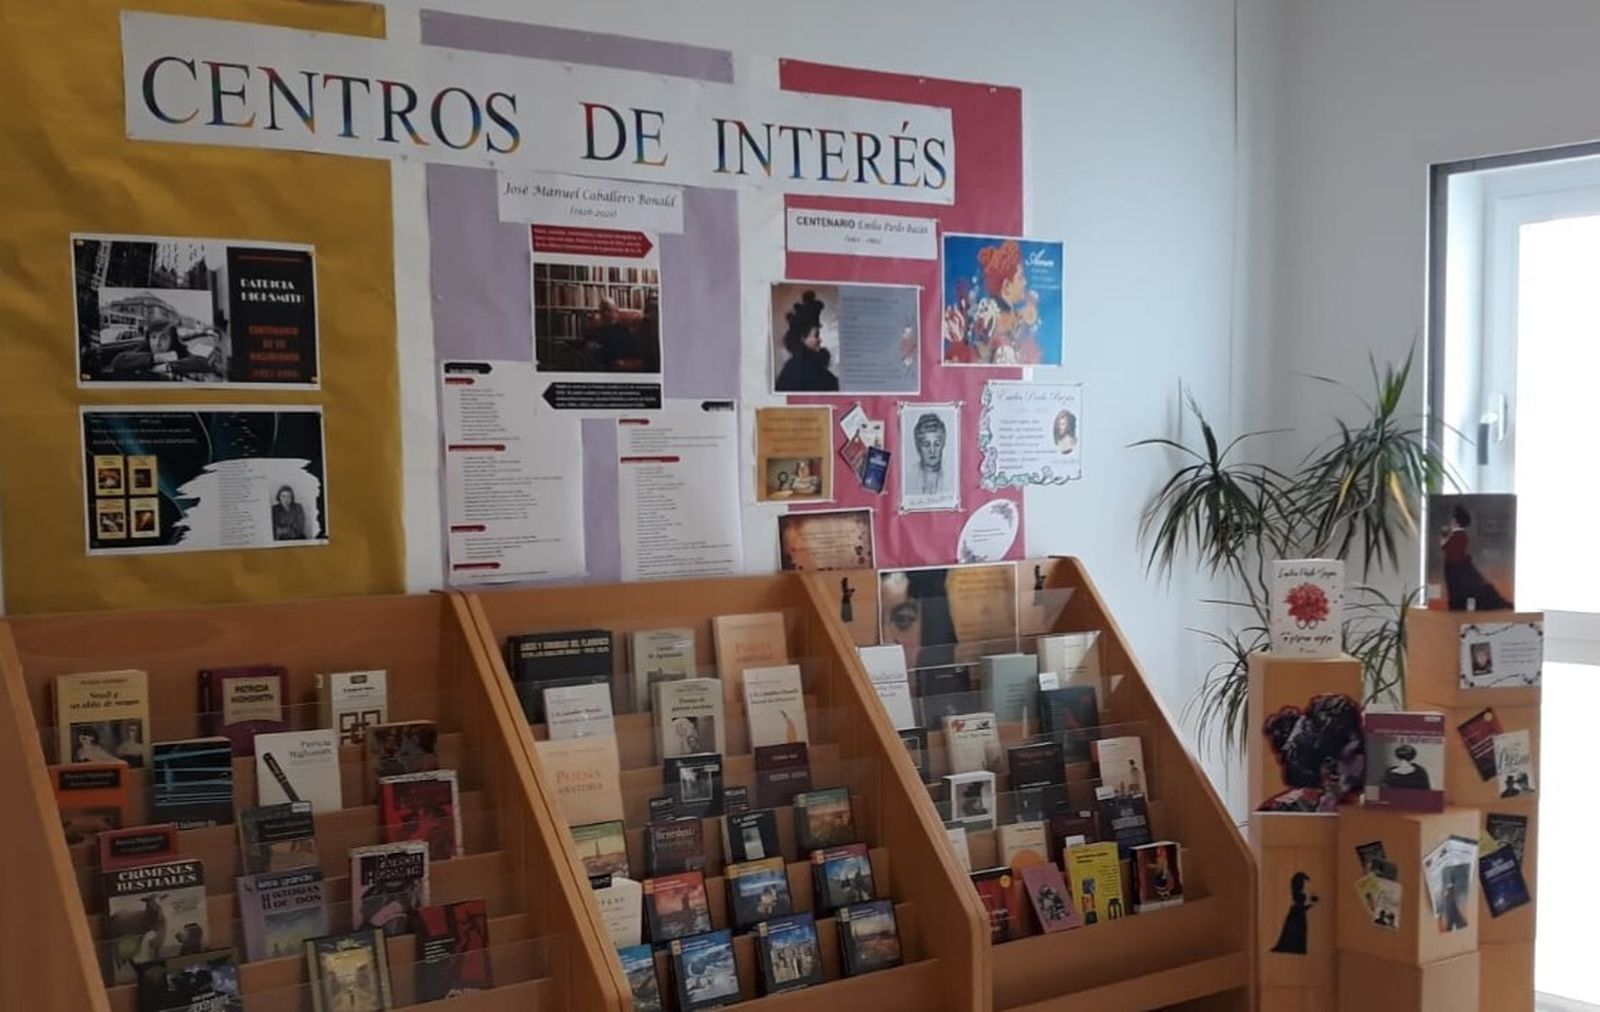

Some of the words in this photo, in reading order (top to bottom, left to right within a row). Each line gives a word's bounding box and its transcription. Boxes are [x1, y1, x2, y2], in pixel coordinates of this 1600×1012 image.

[142, 56, 521, 153] CENTROS
[580, 102, 667, 166] DE
[713, 121, 947, 190] INTERÉS
[533, 185, 579, 200] Manuel
[582, 189, 634, 204] Caballero
[637, 194, 677, 208] Bonald
[796, 216, 856, 230] CENTENARIO
[240, 278, 295, 290] PATRICIA
[240, 291, 304, 303] HIGHSMITH
[117, 874, 198, 892] BESTIALES
